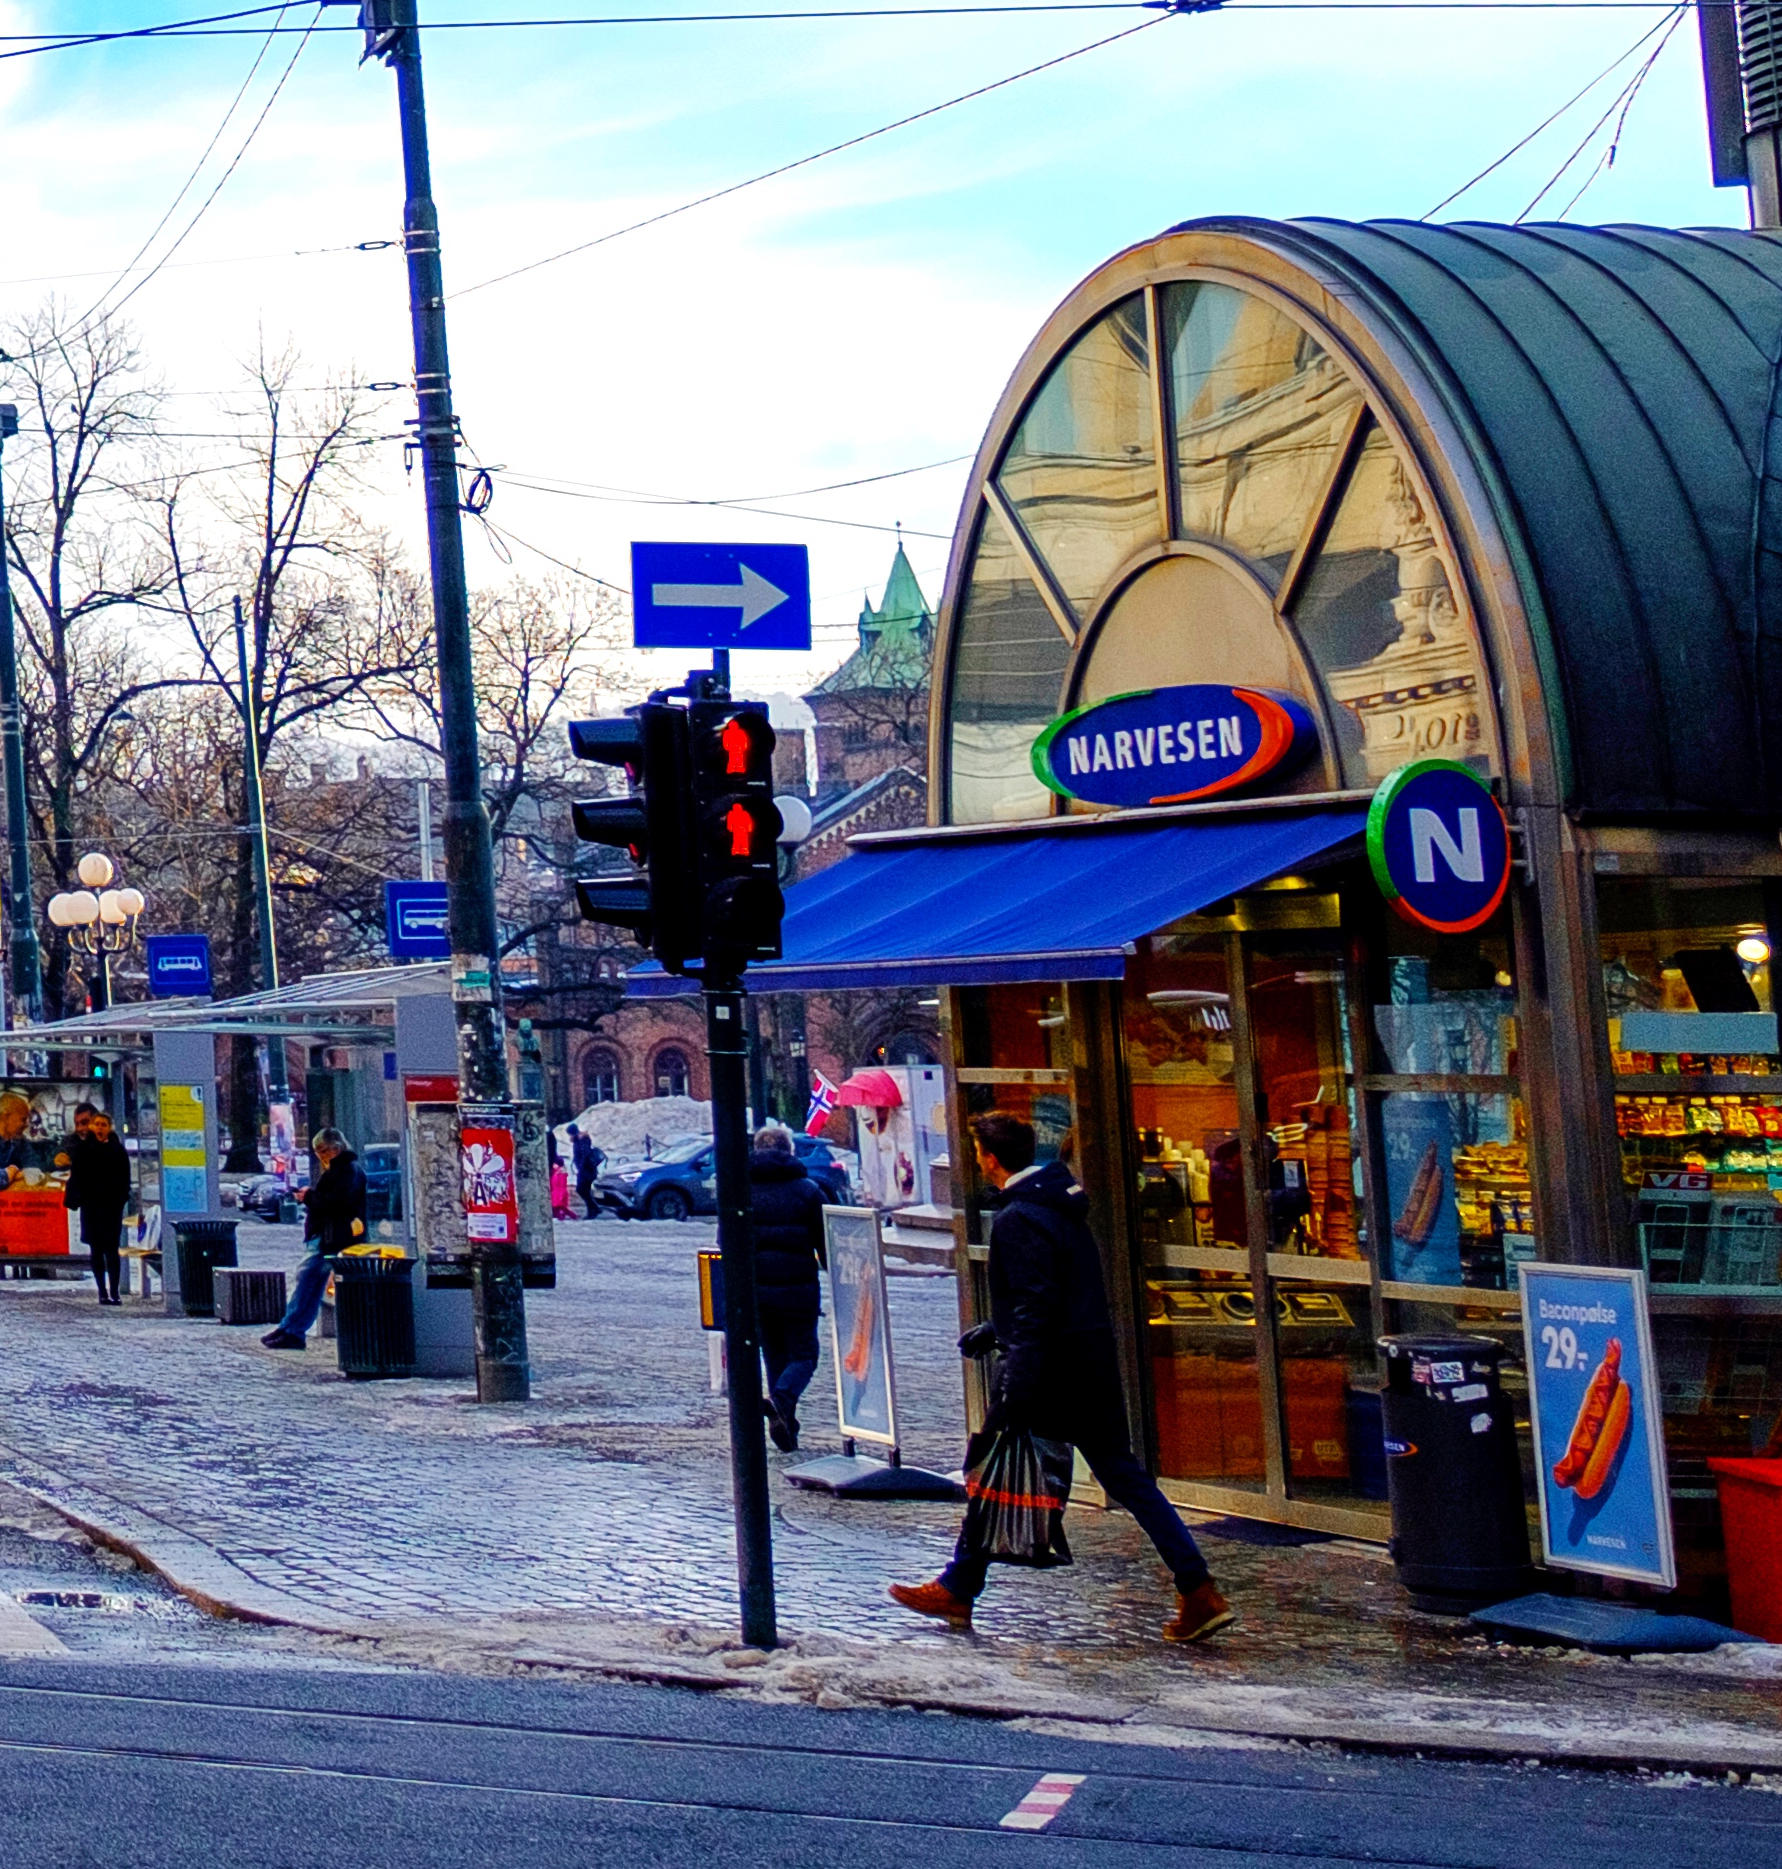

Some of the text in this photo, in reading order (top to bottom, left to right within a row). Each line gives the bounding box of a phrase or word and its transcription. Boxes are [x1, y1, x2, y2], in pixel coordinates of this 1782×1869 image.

[1068, 715, 1243, 775] NARVESEN
[1408, 807, 1485, 883] N
[1649, 1173, 1708, 1189] VG
[1539, 1298, 1617, 1326] Baconpølse
